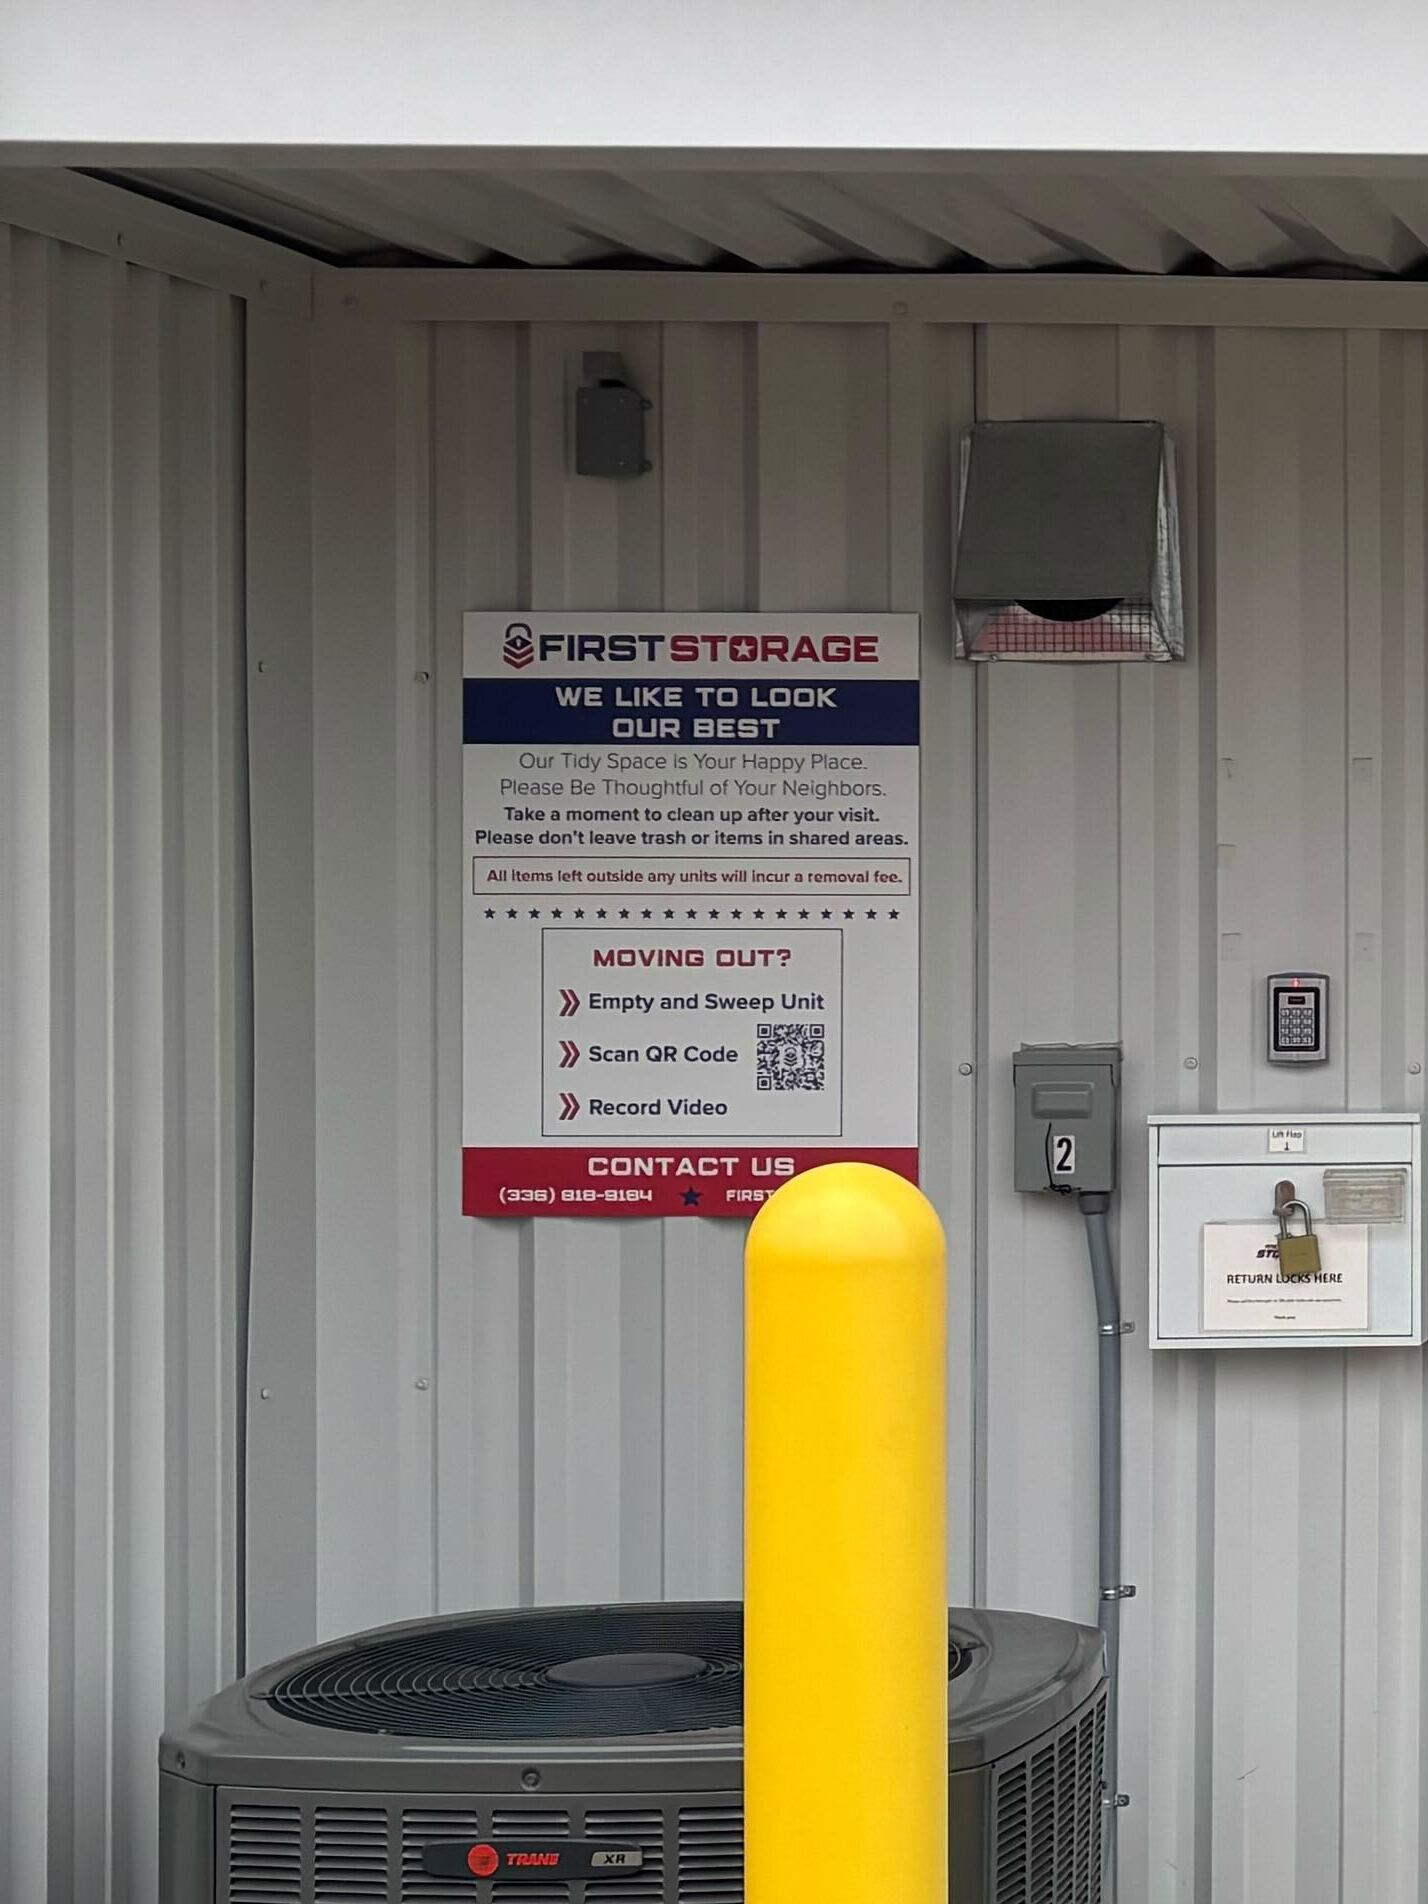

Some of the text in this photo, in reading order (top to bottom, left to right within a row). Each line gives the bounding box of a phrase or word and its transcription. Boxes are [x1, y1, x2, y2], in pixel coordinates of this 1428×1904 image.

[539, 635, 879, 662] FIRST STORAGE
[556, 687, 837, 707] WE LIKE TO LOOK
[613, 718, 780, 738] OUR BEST
[519, 752, 867, 773] Our Tidy Space Is Your Happy Place.
[501, 779, 886, 800] Please Be Thoughtful of Your Neighbors.
[504, 807, 879, 825] Take a moment to clean up after your visit.
[475, 830, 908, 845] Please don't leave trash or items in shared areas.
[487, 869, 902, 885] All items left outside any units will incur a removal fee.
[594, 949, 791, 967] MOVING OUT?
[590, 993, 824, 1013] Empty and Sweep Unit
[589, 1046, 738, 1062] Scan QR Code
[590, 1099, 727, 1115] Record Video
[1056, 1137, 1072, 1172] 2
[588, 1157, 795, 1176] CONTACT US
[1227, 1273, 1343, 1284] RETURN LOCKS HERE
[507, 1853, 560, 1865] TRANE
[604, 1854, 625, 1864] XR
